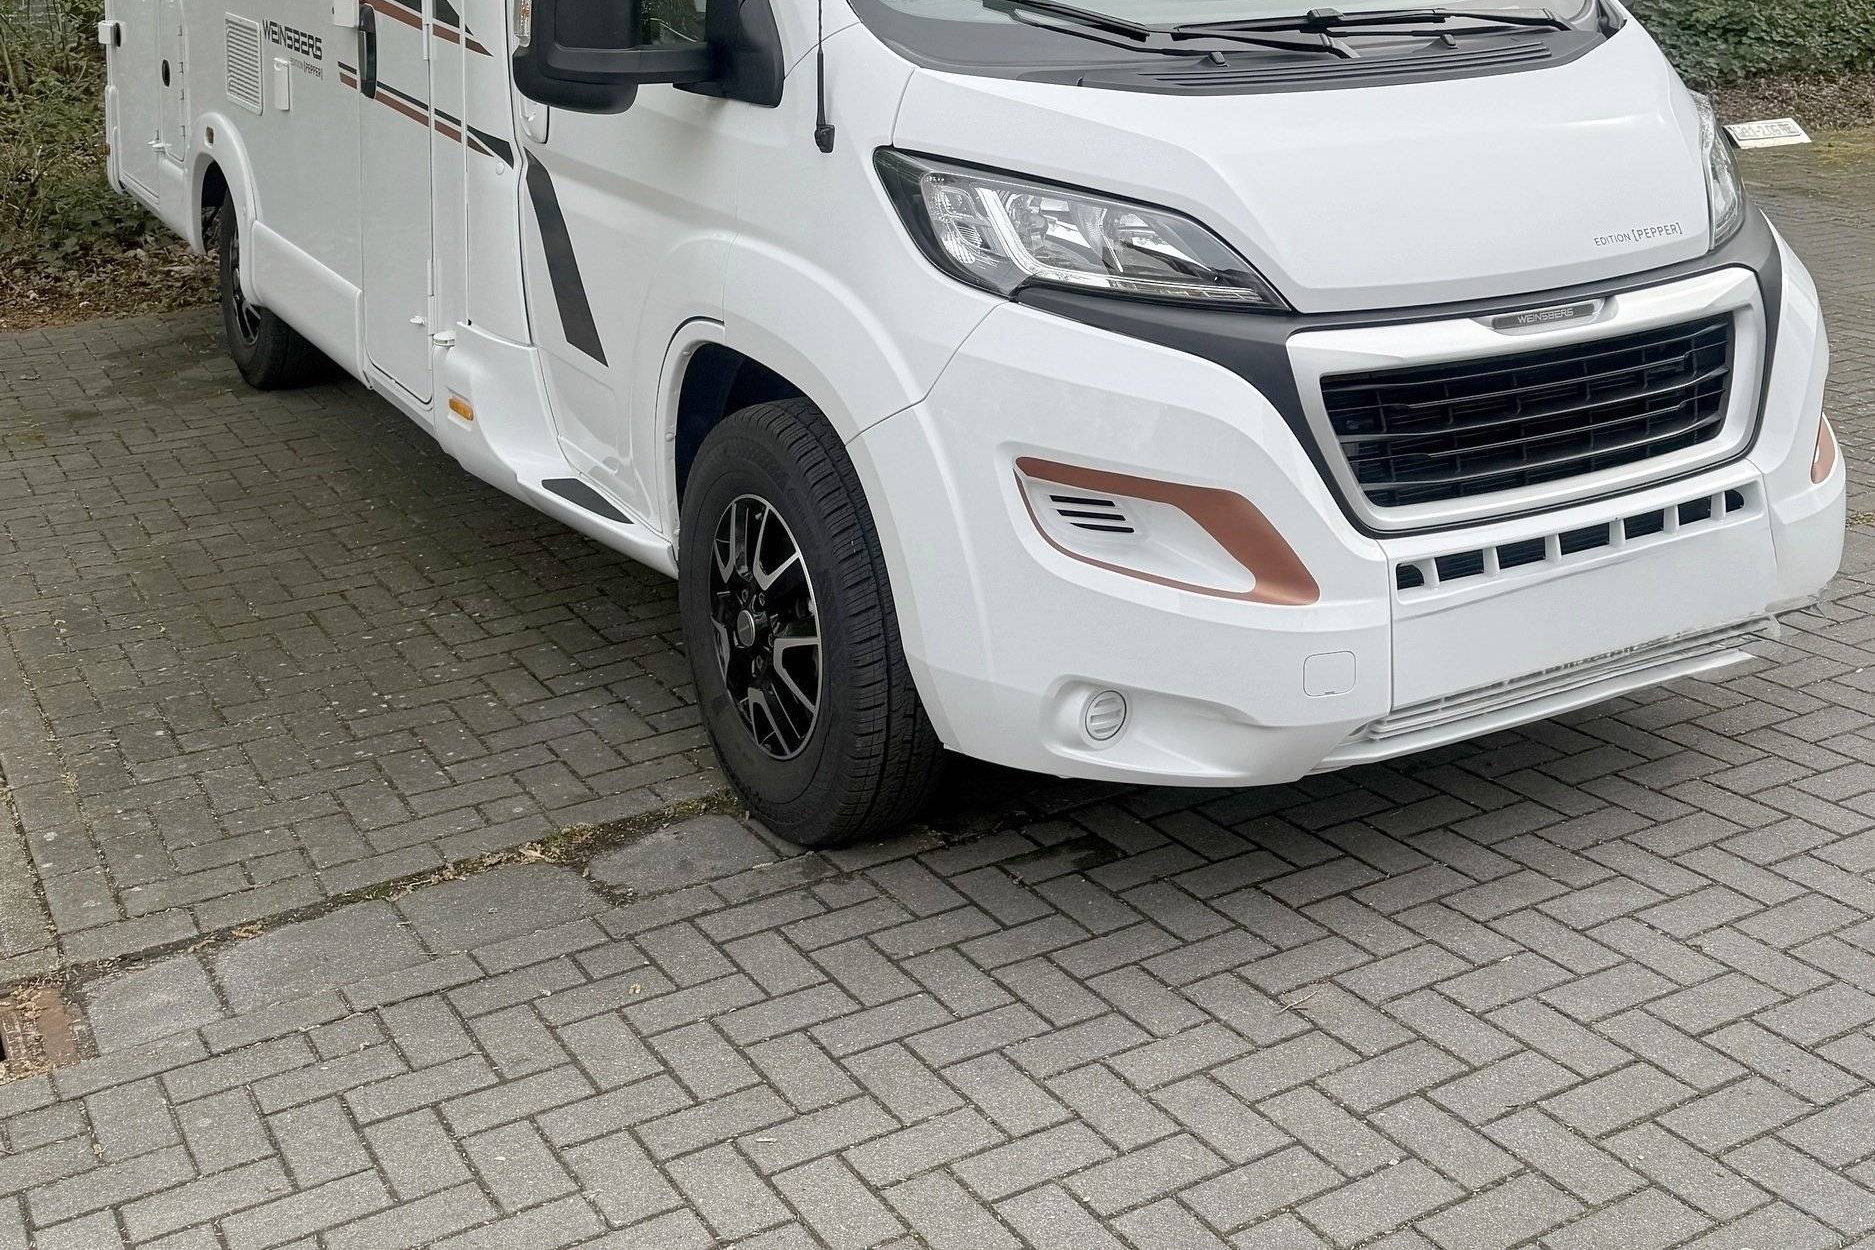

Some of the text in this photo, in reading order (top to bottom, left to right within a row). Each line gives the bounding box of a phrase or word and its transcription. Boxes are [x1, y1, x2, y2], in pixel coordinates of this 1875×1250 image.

[262, 19, 323, 61] WEINSBERG
[1594, 222, 1683, 247] EDITION [PEPPER]
[1517, 308, 1574, 323] WEINSBERG
